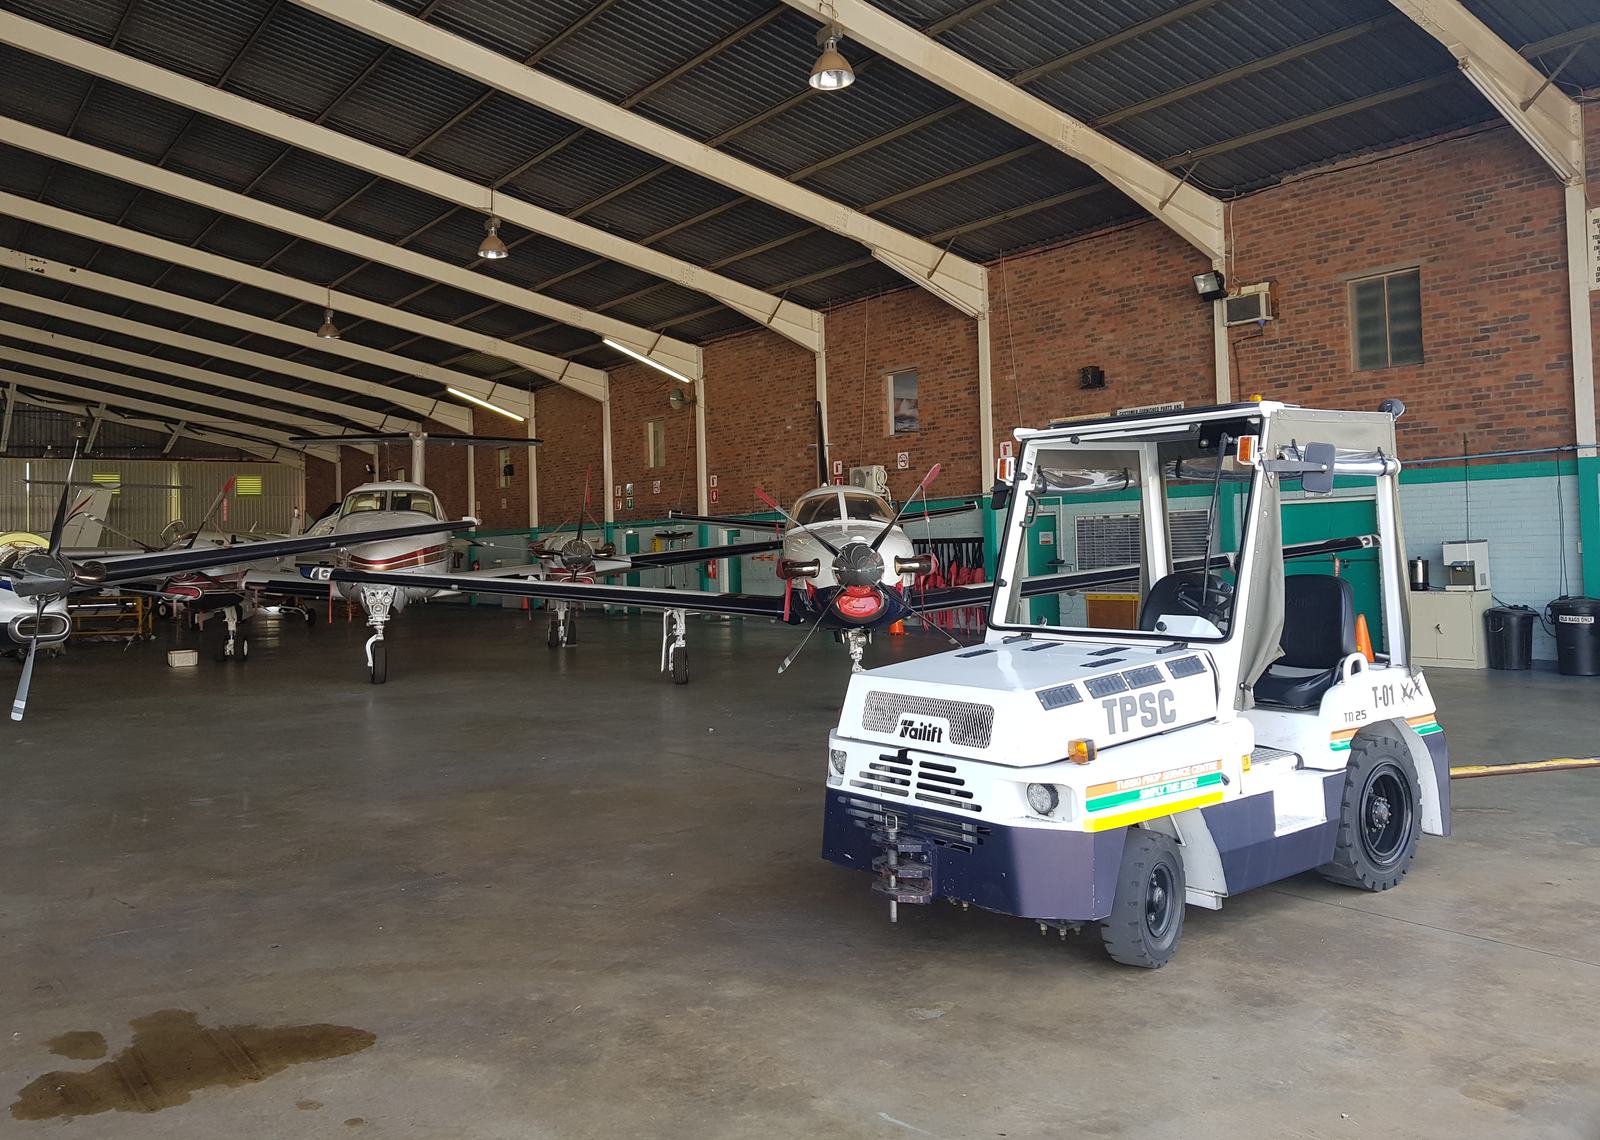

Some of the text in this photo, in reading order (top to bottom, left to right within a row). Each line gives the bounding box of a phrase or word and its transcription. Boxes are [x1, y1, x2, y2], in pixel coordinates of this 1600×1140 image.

[1371, 684, 1394, 708] T-01
[1102, 689, 1176, 735] TPSC
[1356, 709, 1367, 720] 25
[900, 719, 943, 743] Tailift
[1116, 761, 1218, 791] TURBO PROP SERVICE CENTRE
[1140, 778, 1198, 799] SIMPLY THE BEST
